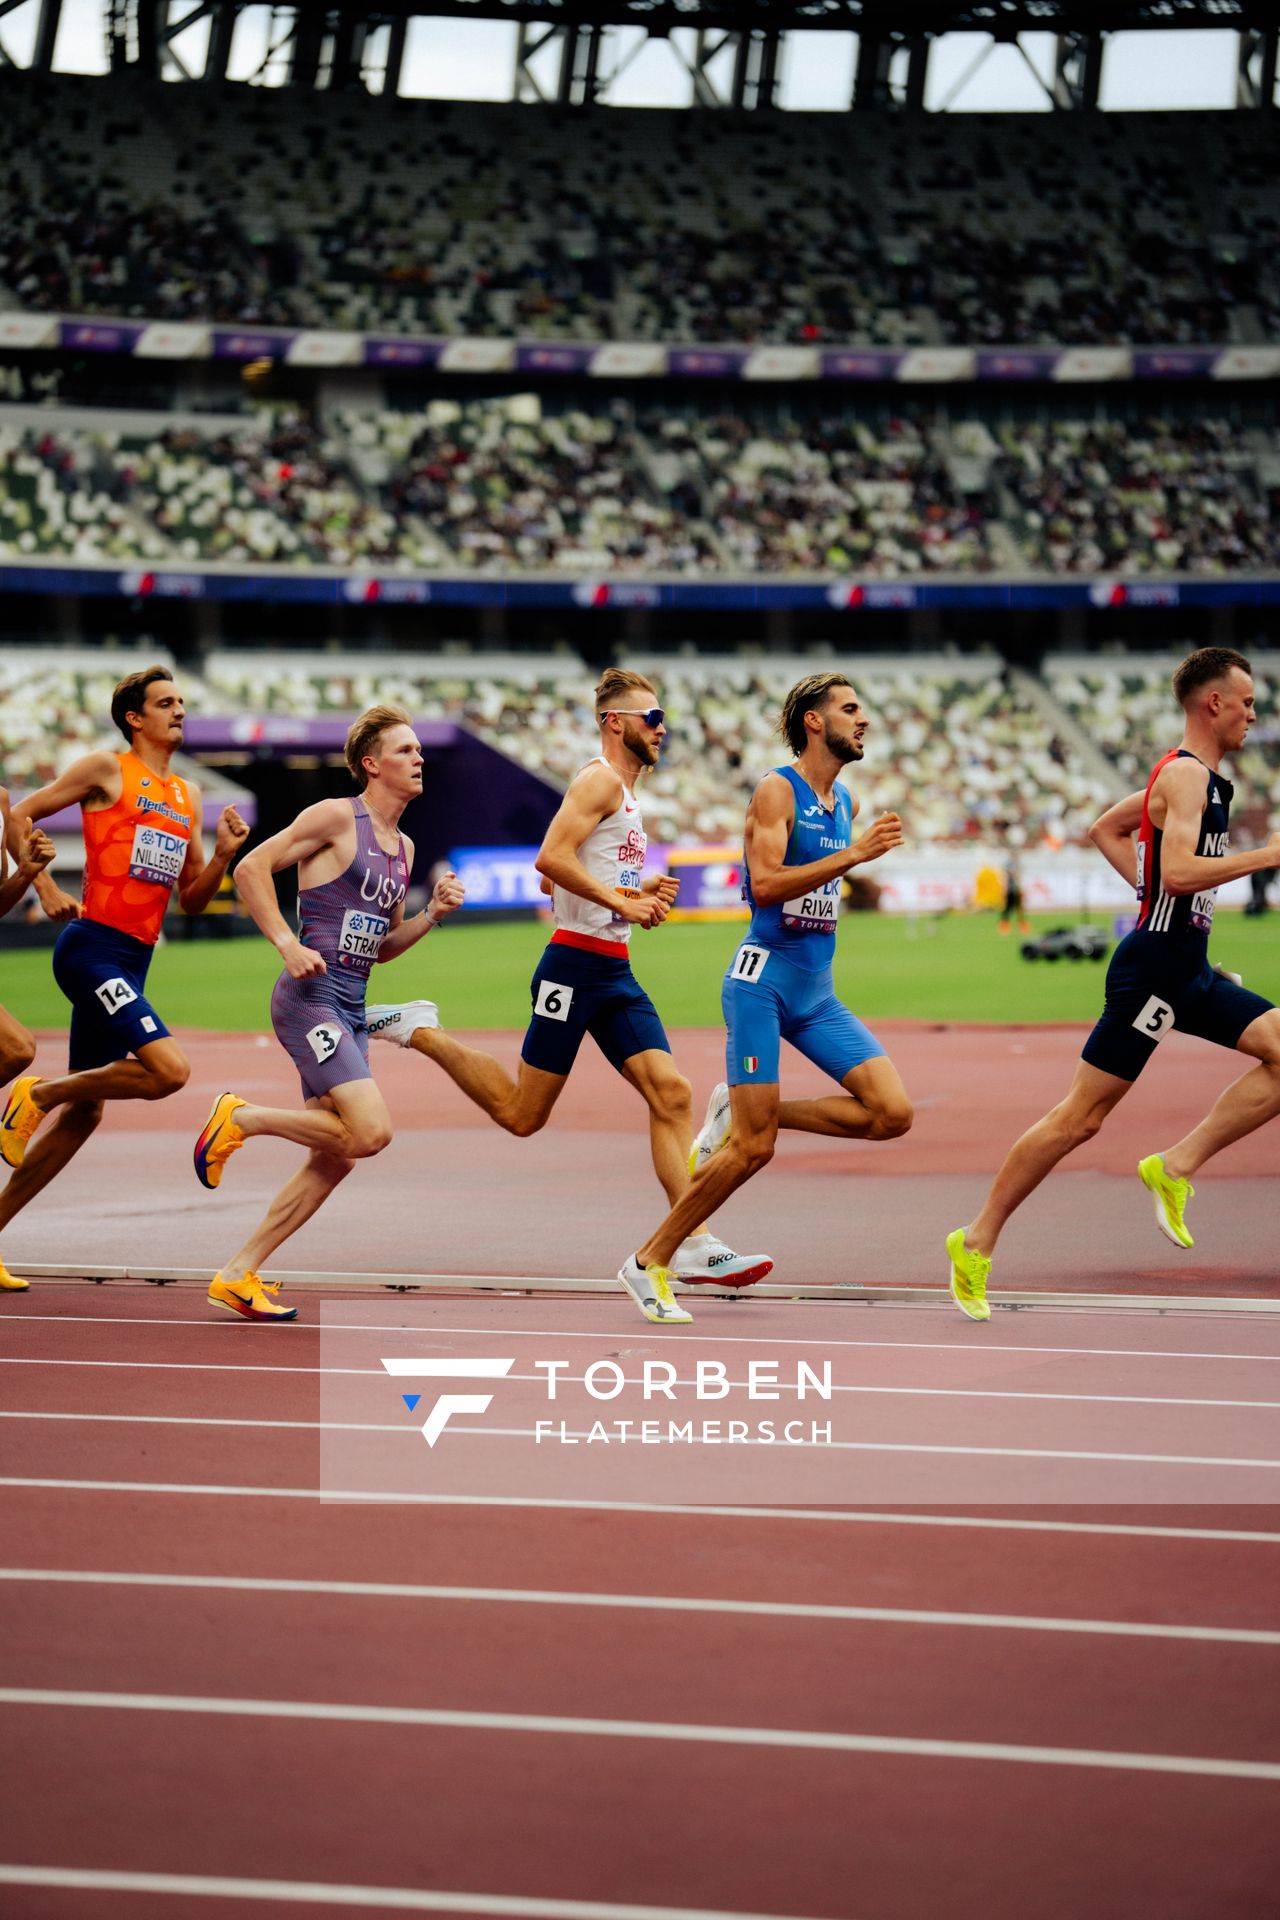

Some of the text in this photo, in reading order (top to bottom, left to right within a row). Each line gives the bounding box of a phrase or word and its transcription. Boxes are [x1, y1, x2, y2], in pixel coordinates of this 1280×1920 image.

[137, 796, 190, 827] Nederland
[155, 833, 185, 856] TDK
[820, 837, 848, 850] ITALIA
[361, 868, 405, 910] USA
[801, 898, 833, 918] RIVA
[739, 950, 761, 976] 11
[101, 983, 131, 1007] 14
[545, 989, 562, 1014] 6
[1146, 1006, 1169, 1032] 5
[316, 1030, 335, 1052] 3
